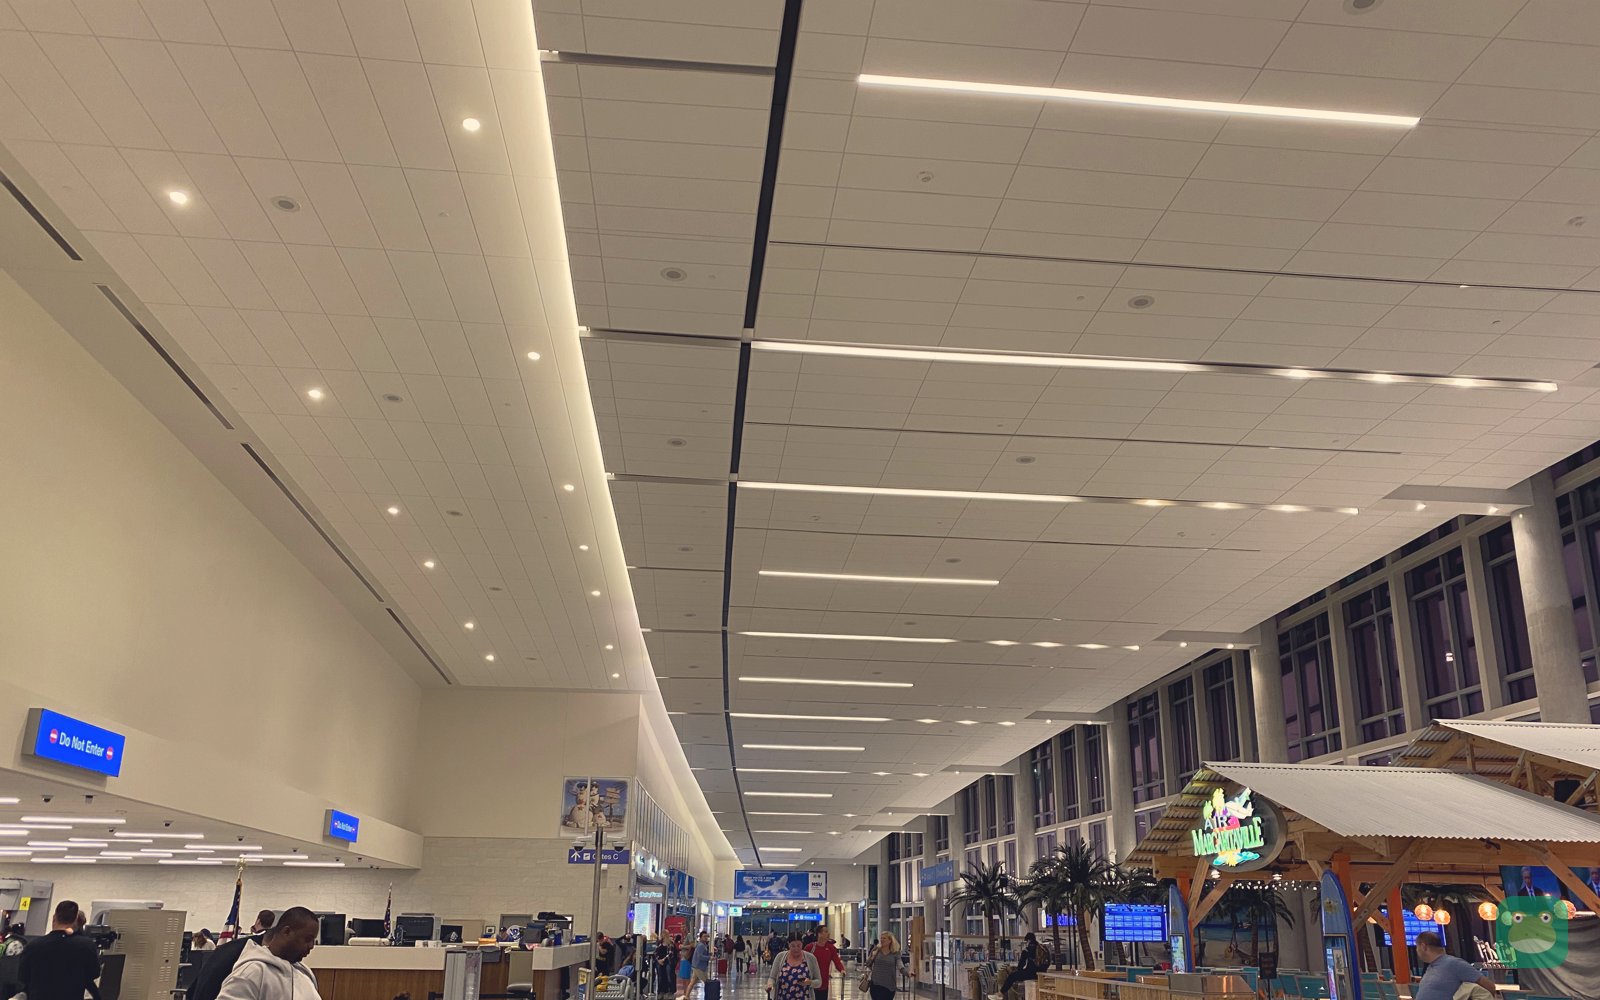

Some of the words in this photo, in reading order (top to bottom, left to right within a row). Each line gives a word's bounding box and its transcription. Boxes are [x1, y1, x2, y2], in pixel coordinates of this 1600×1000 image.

[59, 732, 71, 747] Do
[71, 736, 85, 751] Not
[85, 740, 104, 757] Enter
[1204, 816, 1228, 830] AIR
